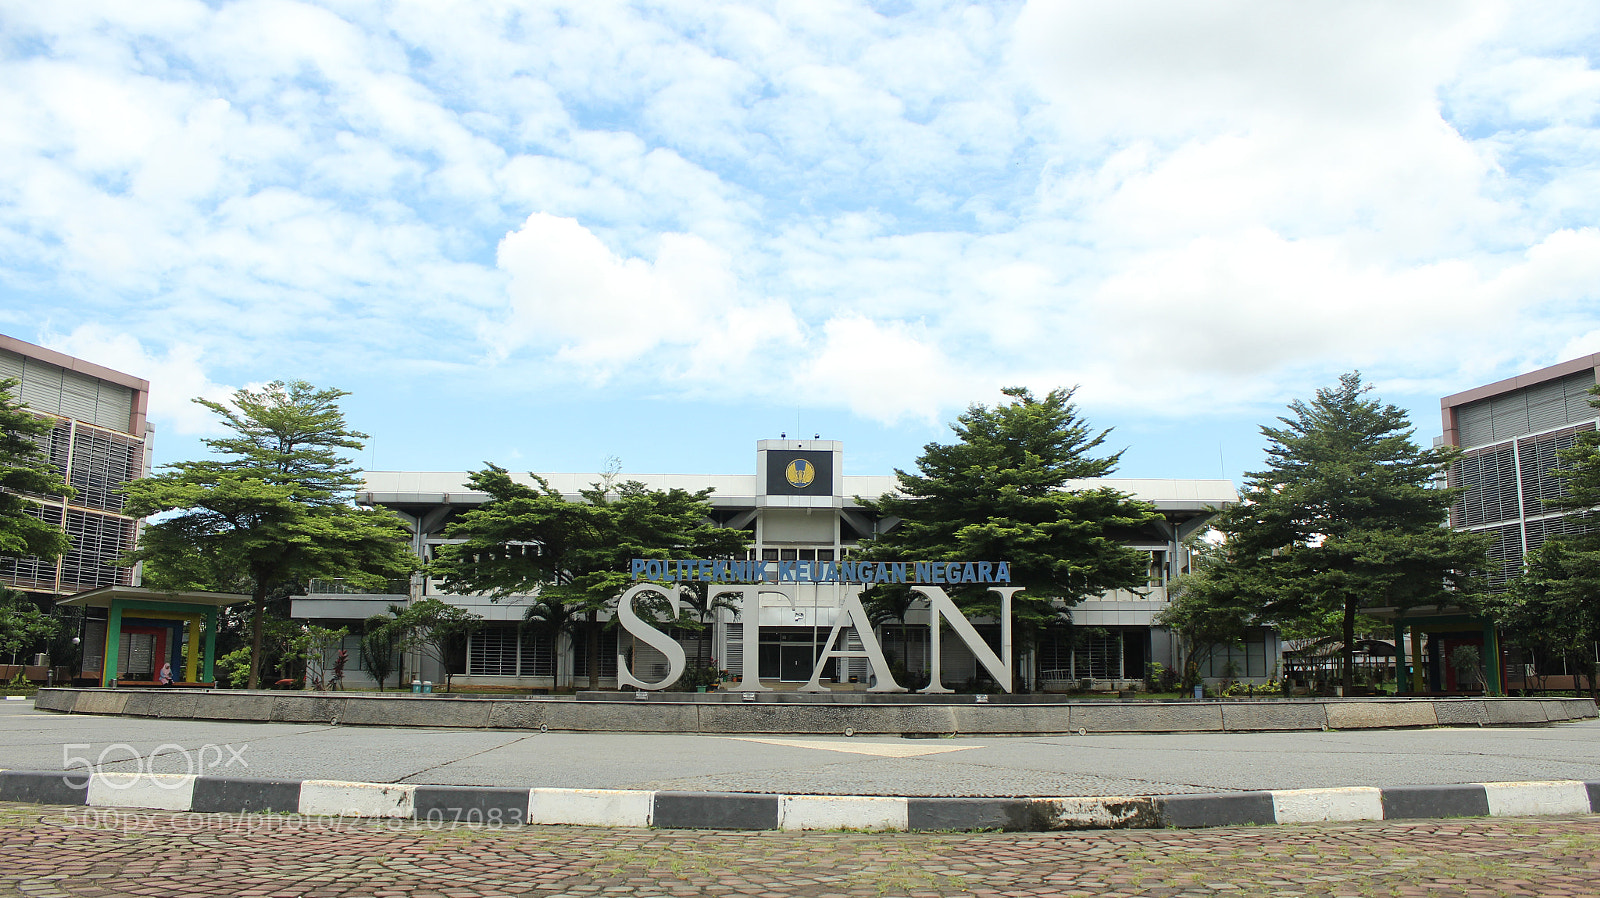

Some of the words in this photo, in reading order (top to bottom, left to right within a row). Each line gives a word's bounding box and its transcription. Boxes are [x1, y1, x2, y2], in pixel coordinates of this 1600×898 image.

[631, 558, 769, 582] POLITEKNIK
[778, 560, 907, 584] KEUANGAN
[915, 561, 1011, 585] NEGARA
[617, 582, 1026, 694] STAN
